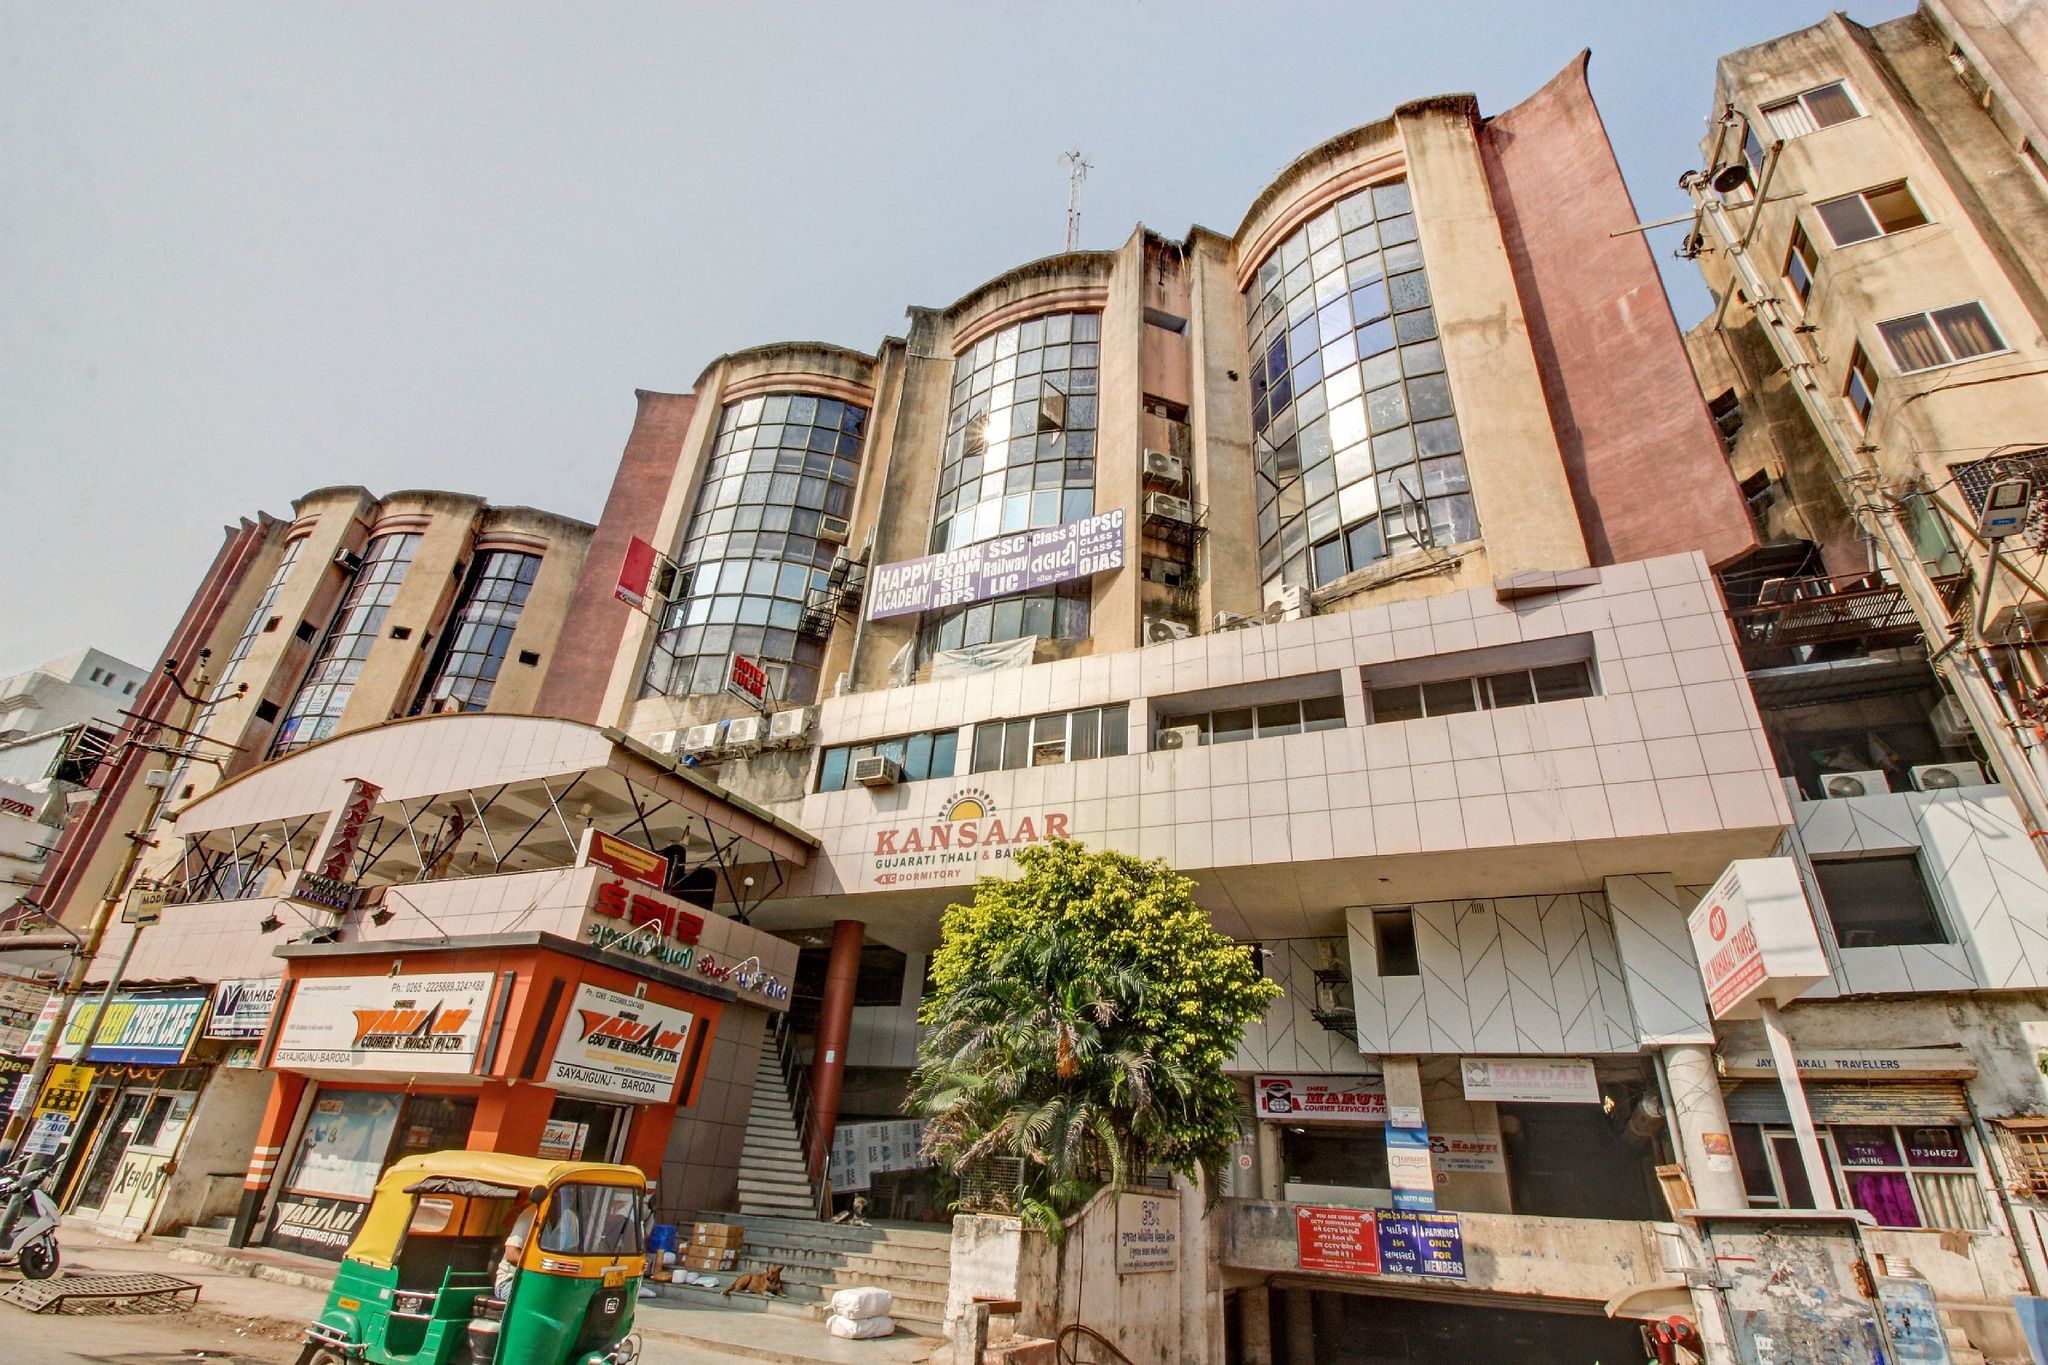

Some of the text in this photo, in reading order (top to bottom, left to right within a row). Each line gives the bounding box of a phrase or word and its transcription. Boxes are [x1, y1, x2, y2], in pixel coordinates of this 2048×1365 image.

[1080, 510, 1123, 536] GPSC
[1032, 523, 1077, 547] Class 3
[1080, 529, 1121, 546] CLASS 1
[935, 546, 983, 567] BANK
[989, 535, 1026, 559] SSC
[1080, 539, 1122, 556] CLASS 2
[934, 558, 981, 581] EXAM
[983, 554, 1028, 578] Railway
[1080, 550, 1122, 576] OJAS
[879, 563, 933, 592] HAPPY
[940, 575, 971, 592] SBI
[990, 573, 1019, 596] LIC
[875, 585, 930, 613] ACADEMY
[934, 587, 975, 609] IBPS
[874, 813, 1071, 856] KANSAAR
[875, 854, 936, 870] GUJARATI
[940, 850, 977, 865] THALI
[981, 849, 990, 861] &
[898, 869, 961, 882] DORMITORY
[240, 988, 279, 1001] MAHABA
[405, 982, 422, 992] 0265
[121, 1004, 168, 1045] CYBER
[157, 1004, 199, 1046] CAFE
[361, 1036, 394, 1048] COURIER
[394, 1036, 432, 1049] SRVICES
[445, 1037, 463, 1050] LTD.
[588, 1034, 621, 1050] COUIER
[622, 1042, 654, 1058] SERVICES
[0, 1055, 31, 1073] Spee
[1494, 1068, 1586, 1081] NANDAN
[1755, 1059, 1772, 1068] JAY
[1835, 1059, 1900, 1069] TRAVELLERS
[557, 1067, 612, 1086] SAYAJIGUNJ
[621, 1078, 656, 1094] BARODA
[1544, 1081, 1587, 1089] LIMITED
[1305, 1093, 1386, 1106] MARUT
[114, 1162, 167, 1198] XEROX
[279, 1223, 303, 1237] COURIER
[301, 1228, 328, 1243] SERVICES
[1425, 1228, 1455, 1238] PARKING
[1424, 1260, 1464, 1274] MEMBERS
